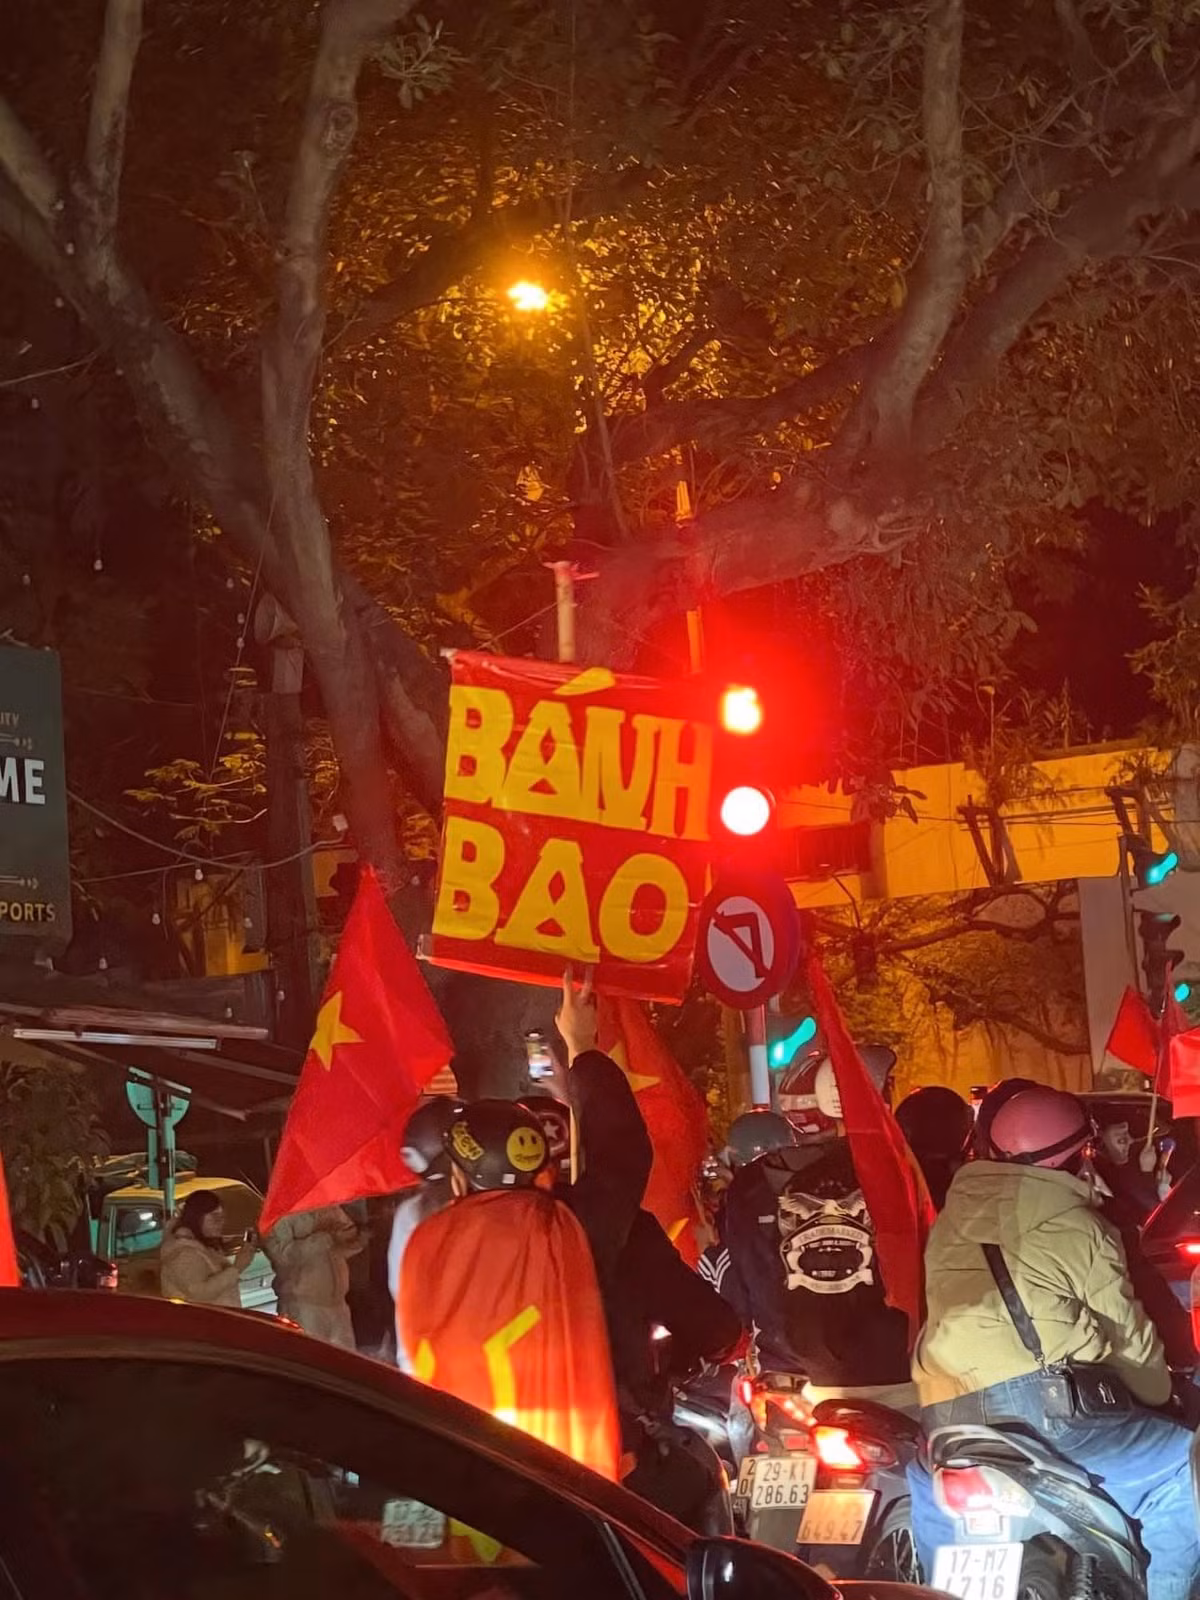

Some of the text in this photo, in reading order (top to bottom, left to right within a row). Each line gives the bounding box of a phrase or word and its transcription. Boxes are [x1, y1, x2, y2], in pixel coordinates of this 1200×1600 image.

[443, 667, 713, 842] BÁNH
[0, 756, 46, 805] ME
[432, 815, 690, 963] BAO
[0, 900, 56, 923] PORTS
[762, 1461, 807, 1482] 29-K1
[755, 1483, 810, 1506] 286.63
[950, 1547, 1009, 1574] 17-M7
